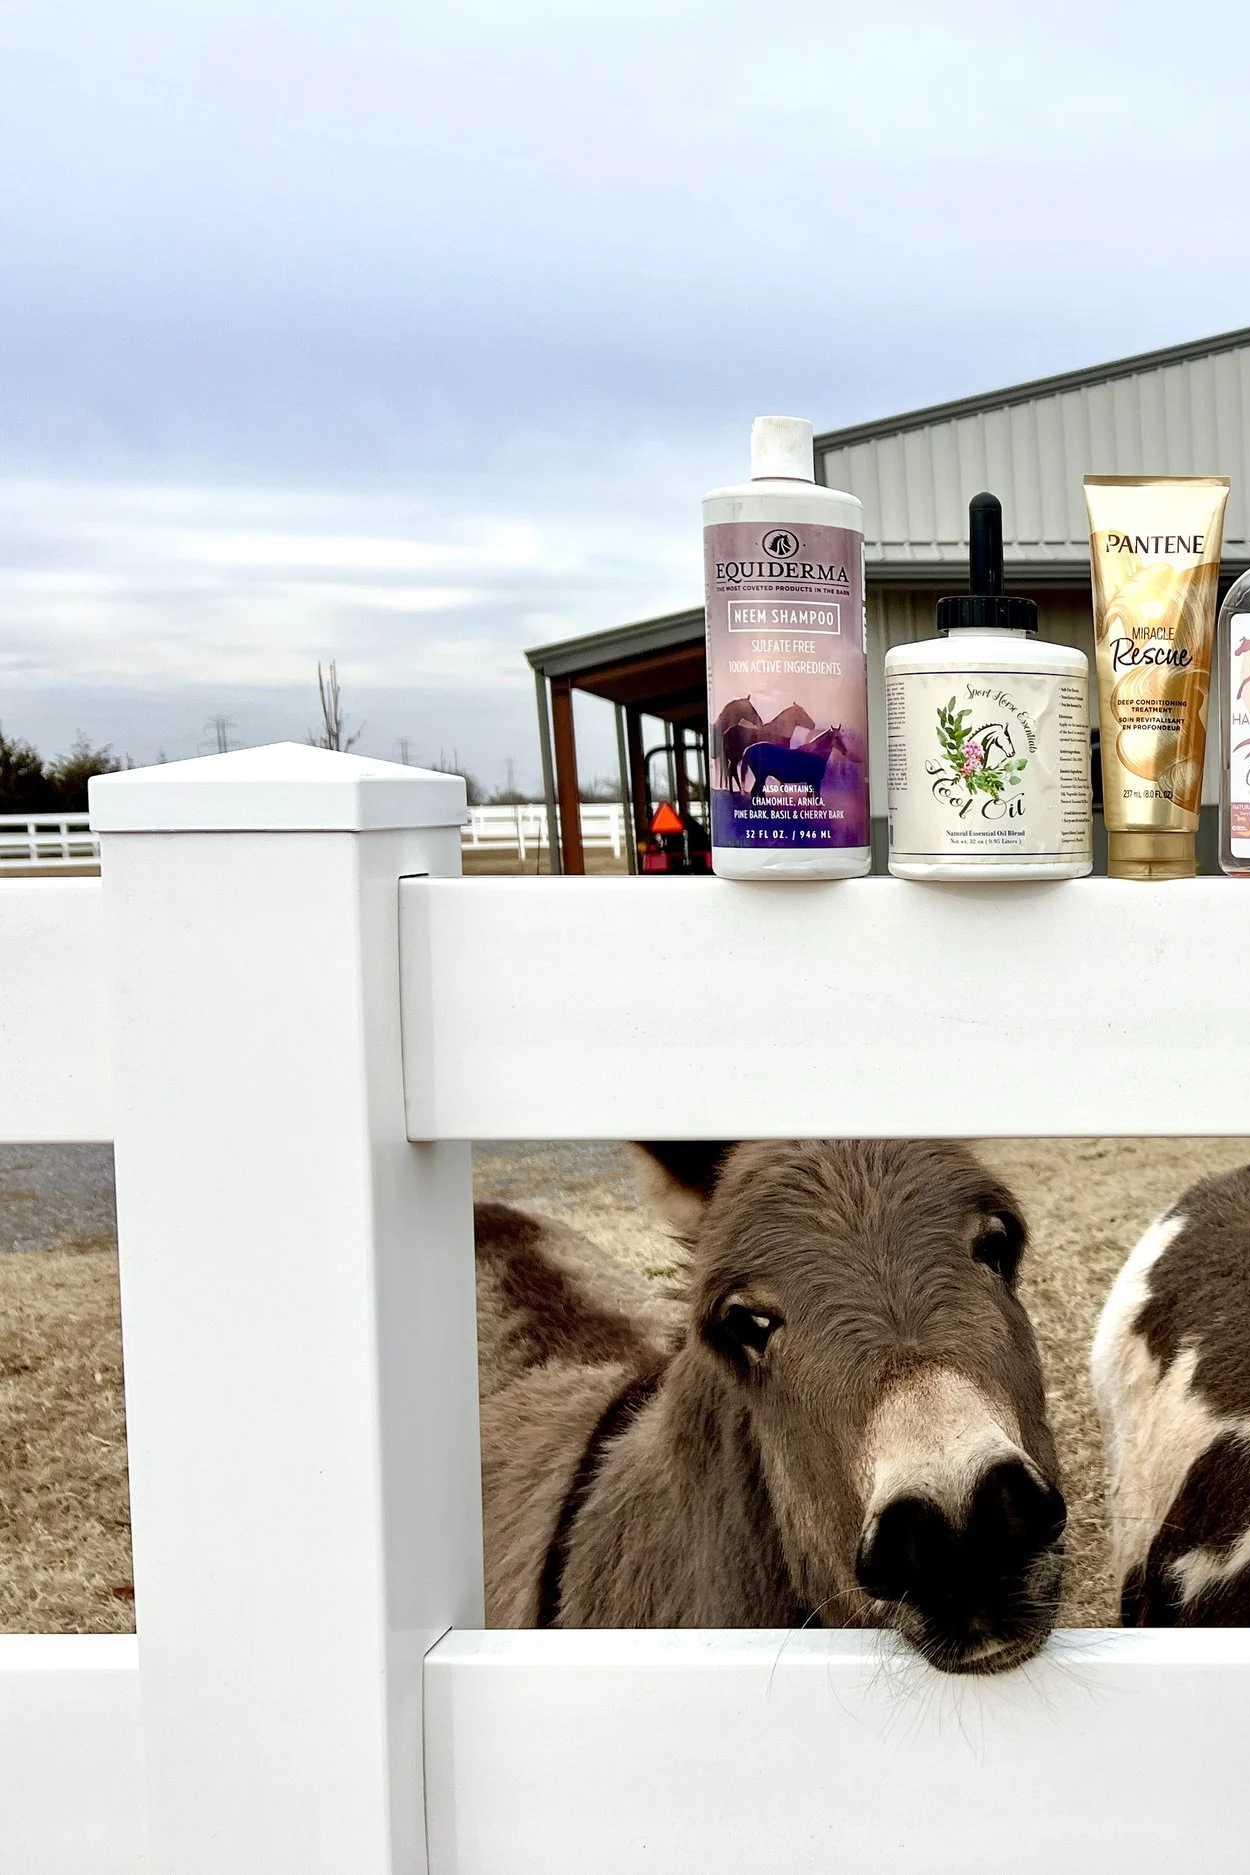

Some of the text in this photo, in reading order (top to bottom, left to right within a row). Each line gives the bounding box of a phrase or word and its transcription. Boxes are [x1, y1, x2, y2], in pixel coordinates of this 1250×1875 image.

[1106, 534, 1204, 554] PANTENE
[716, 561, 850, 583] EQUIDERMA
[734, 609, 834, 626] NEEM SHAMPOO
[1132, 627, 1175, 640] MIRACLE
[751, 639, 816, 654] SULFATE FREE
[1110, 637, 1193, 672] Rescue
[728, 660, 842, 675] 100% ACTIVE INGREDIENTS
[965, 683, 991, 700] Sport
[992, 690, 1018, 713] Horse
[1017, 710, 1038, 754] Essentials
[762, 784, 815, 793] ALSO CONTAINS:
[1123, 790, 1133, 798] 237
[981, 792, 1026, 820] Oil
[734, 810, 748, 819] PINE
[770, 810, 790, 819] BASIL
[792, 810, 799, 819] &
[800, 810, 828, 819] CHERRY
[828, 810, 845, 819] BARK
[745, 830, 755, 839] 32
[759, 830, 769, 839] FL
[772, 830, 788, 839] OZ.
[800, 830, 817, 839] 946
[820, 830, 832, 839] ML
